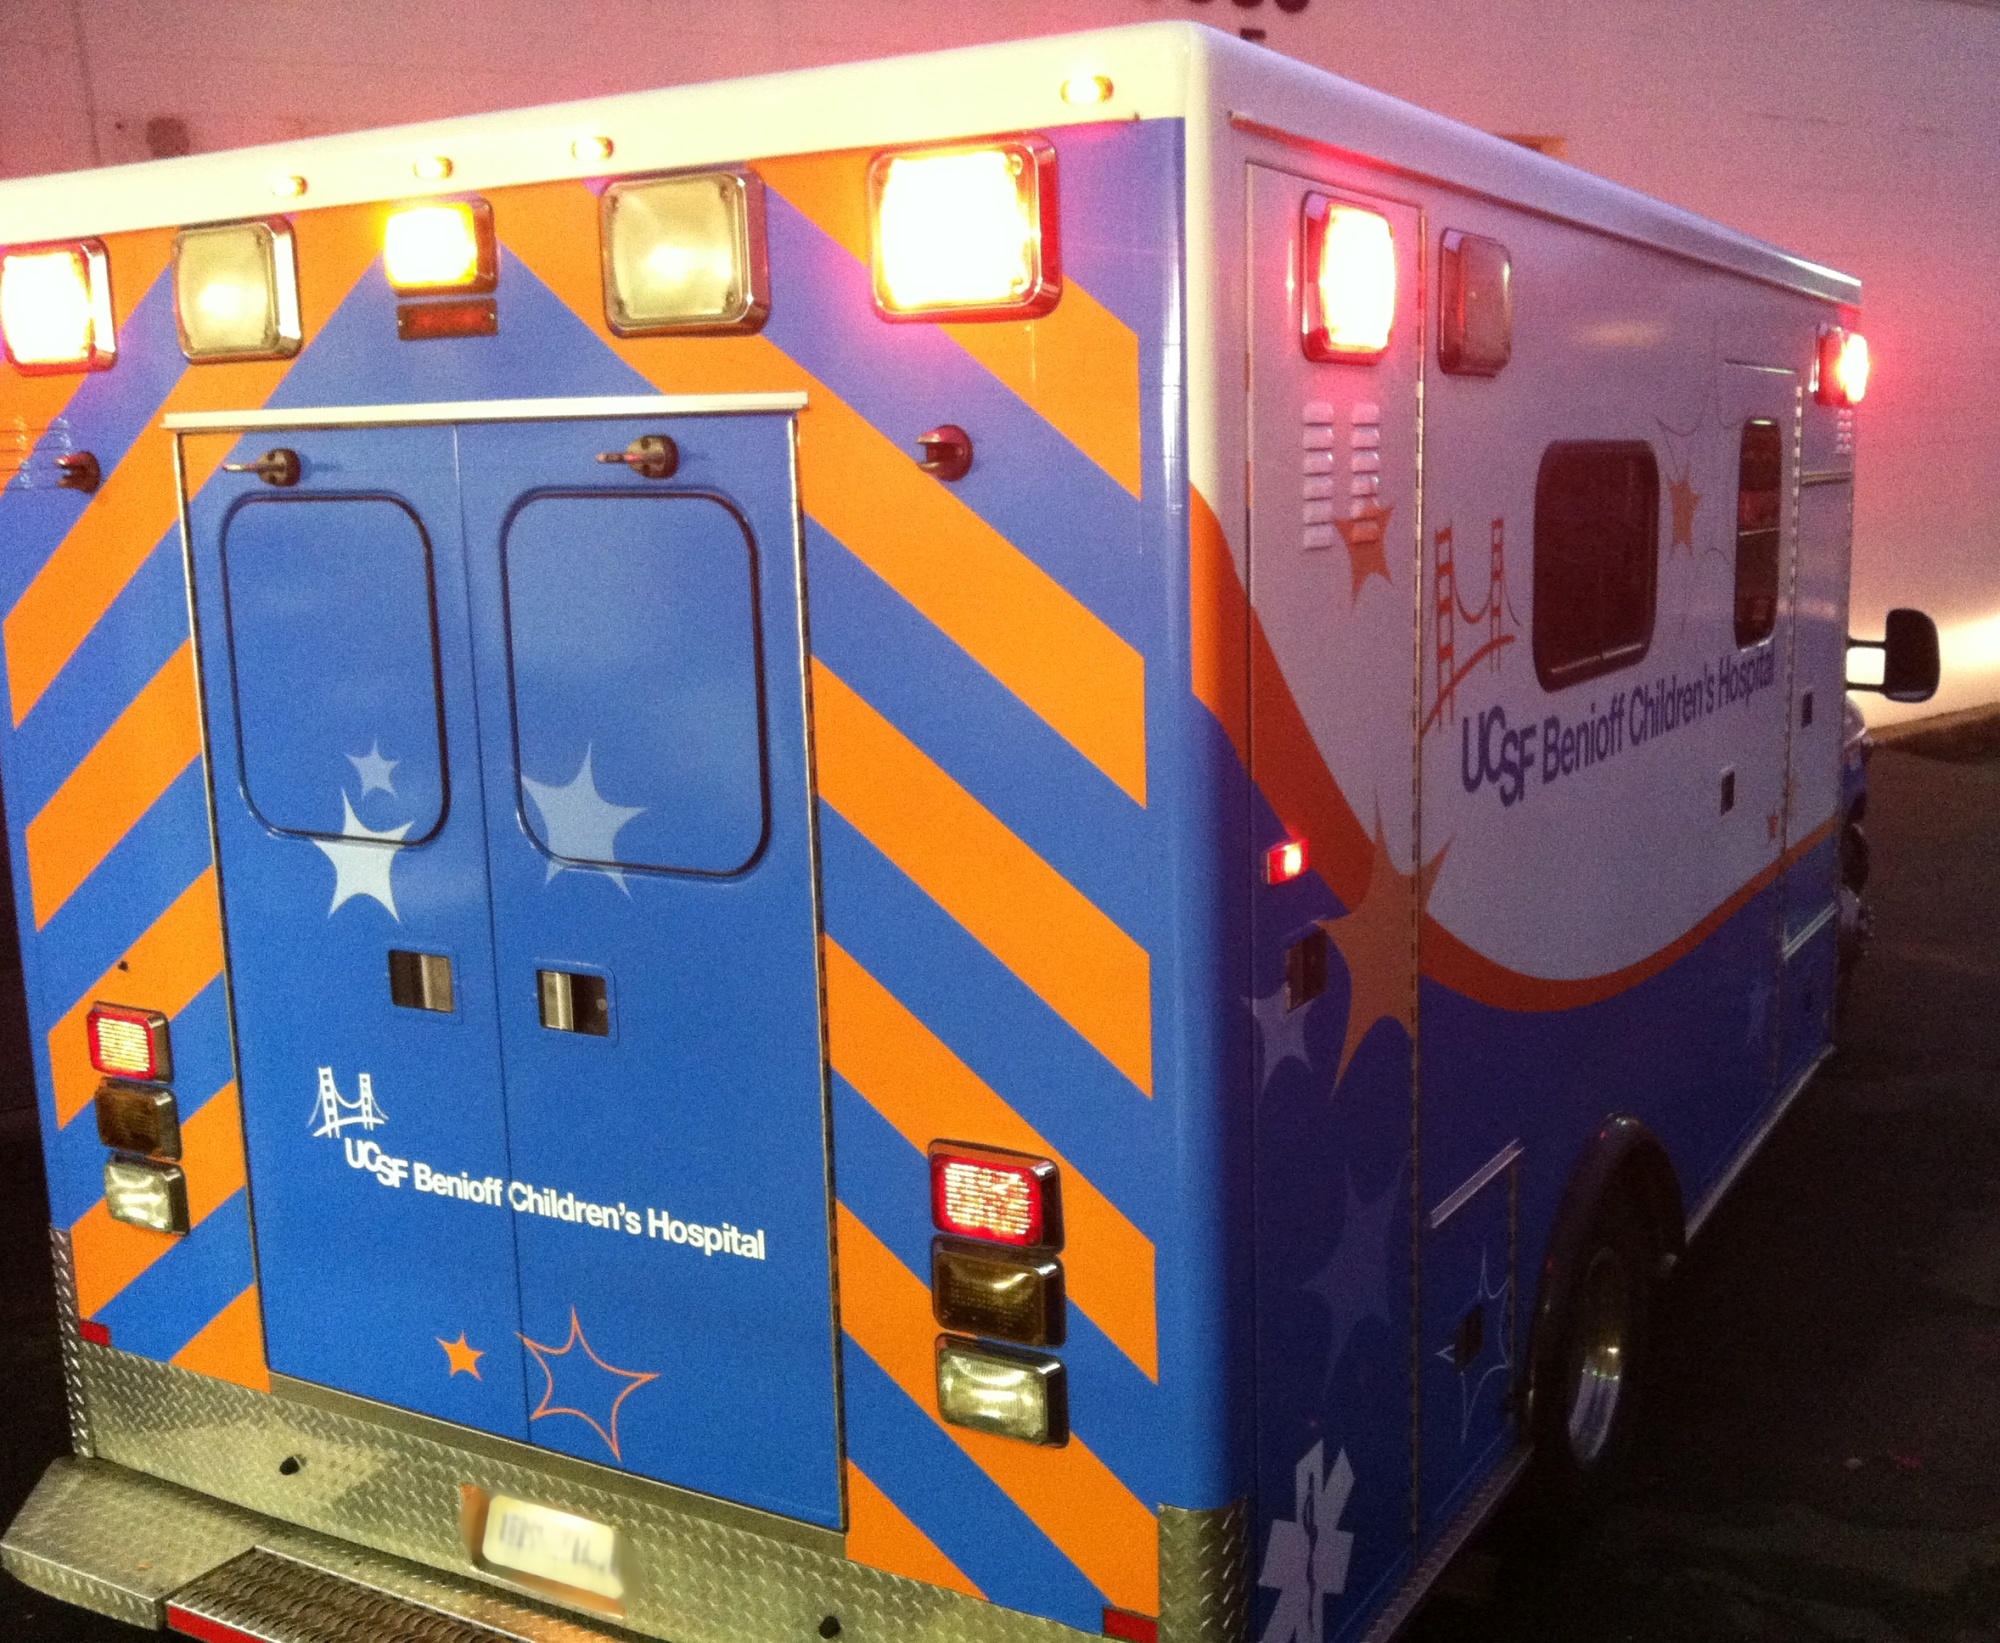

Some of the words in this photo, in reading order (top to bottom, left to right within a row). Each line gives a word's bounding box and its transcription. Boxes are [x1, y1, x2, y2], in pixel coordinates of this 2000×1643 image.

[1462, 706, 1537, 807] UCSF
[1542, 692, 1625, 784] Benioff
[1628, 664, 1716, 746] Children's
[1718, 640, 1775, 708] Hospital
[345, 1137, 408, 1188] UCSF
[413, 1162, 503, 1207] Benioff
[508, 1181, 642, 1236] Children's
[647, 1208, 767, 1261] Hospital
